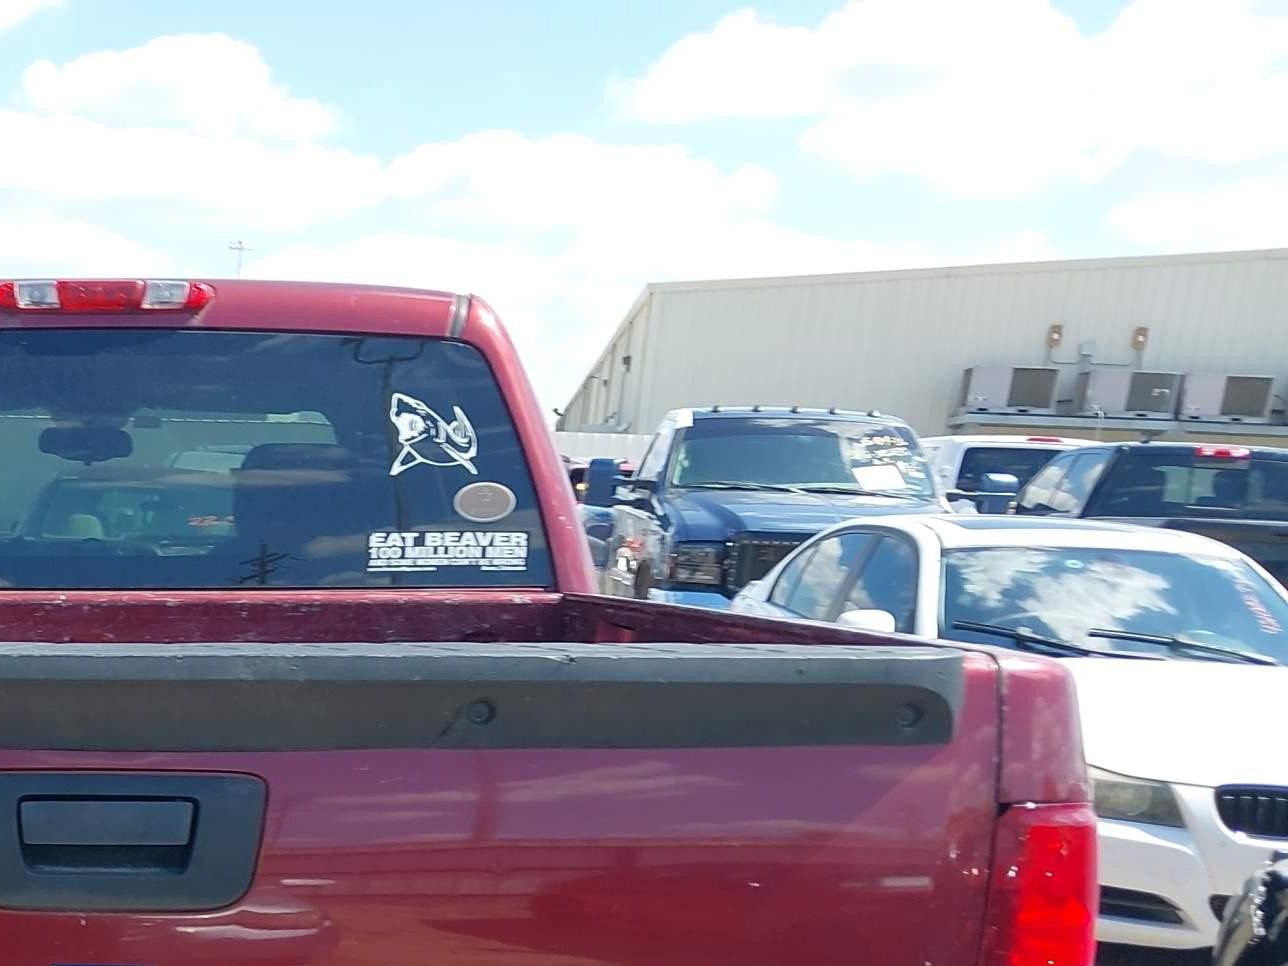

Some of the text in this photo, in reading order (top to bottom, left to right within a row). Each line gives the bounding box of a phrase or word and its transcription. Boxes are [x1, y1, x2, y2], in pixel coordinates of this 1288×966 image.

[368, 532, 528, 547] EAT BEAVER
[404, 547, 483, 558] MILLION
[485, 547, 528, 558] MEN
